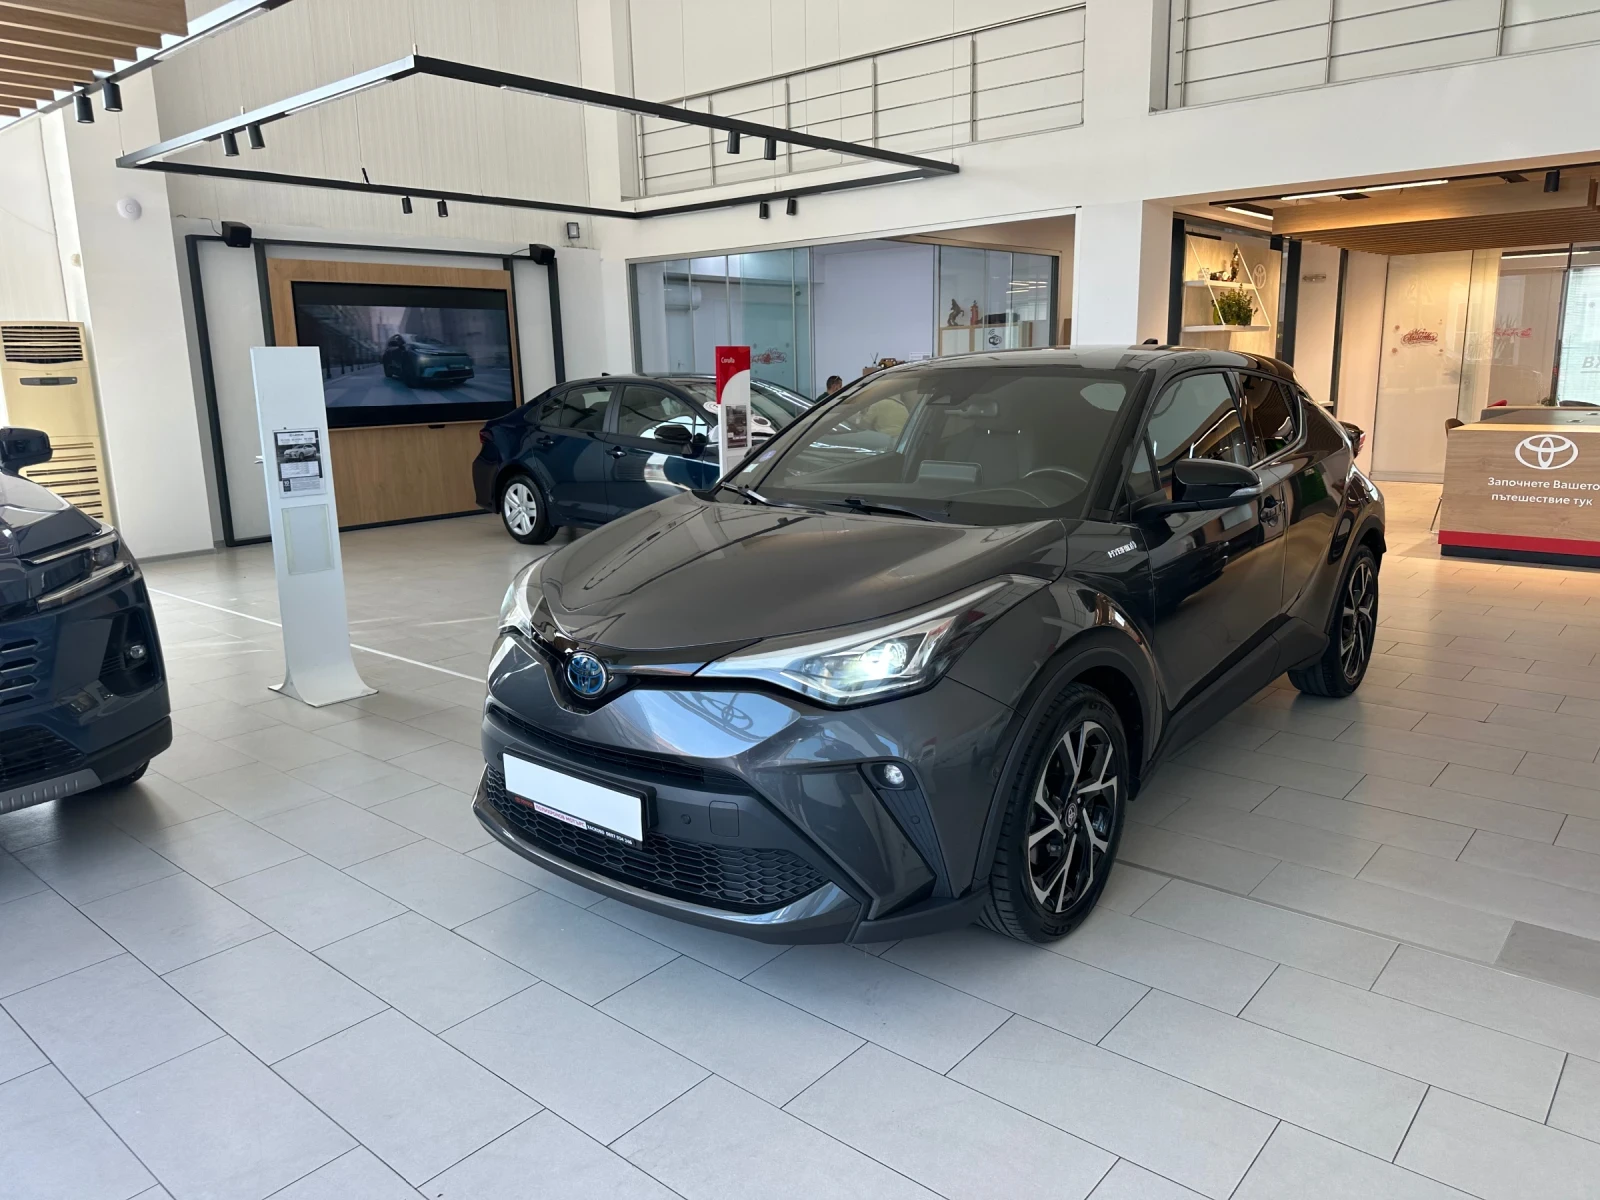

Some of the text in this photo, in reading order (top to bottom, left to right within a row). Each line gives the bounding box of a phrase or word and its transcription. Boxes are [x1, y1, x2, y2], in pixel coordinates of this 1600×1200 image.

[1487, 477, 1600, 491] Започнете Вашето
[1491, 493, 1593, 508] пътешествие тук
[1107, 540, 1137, 558] HYBRID
